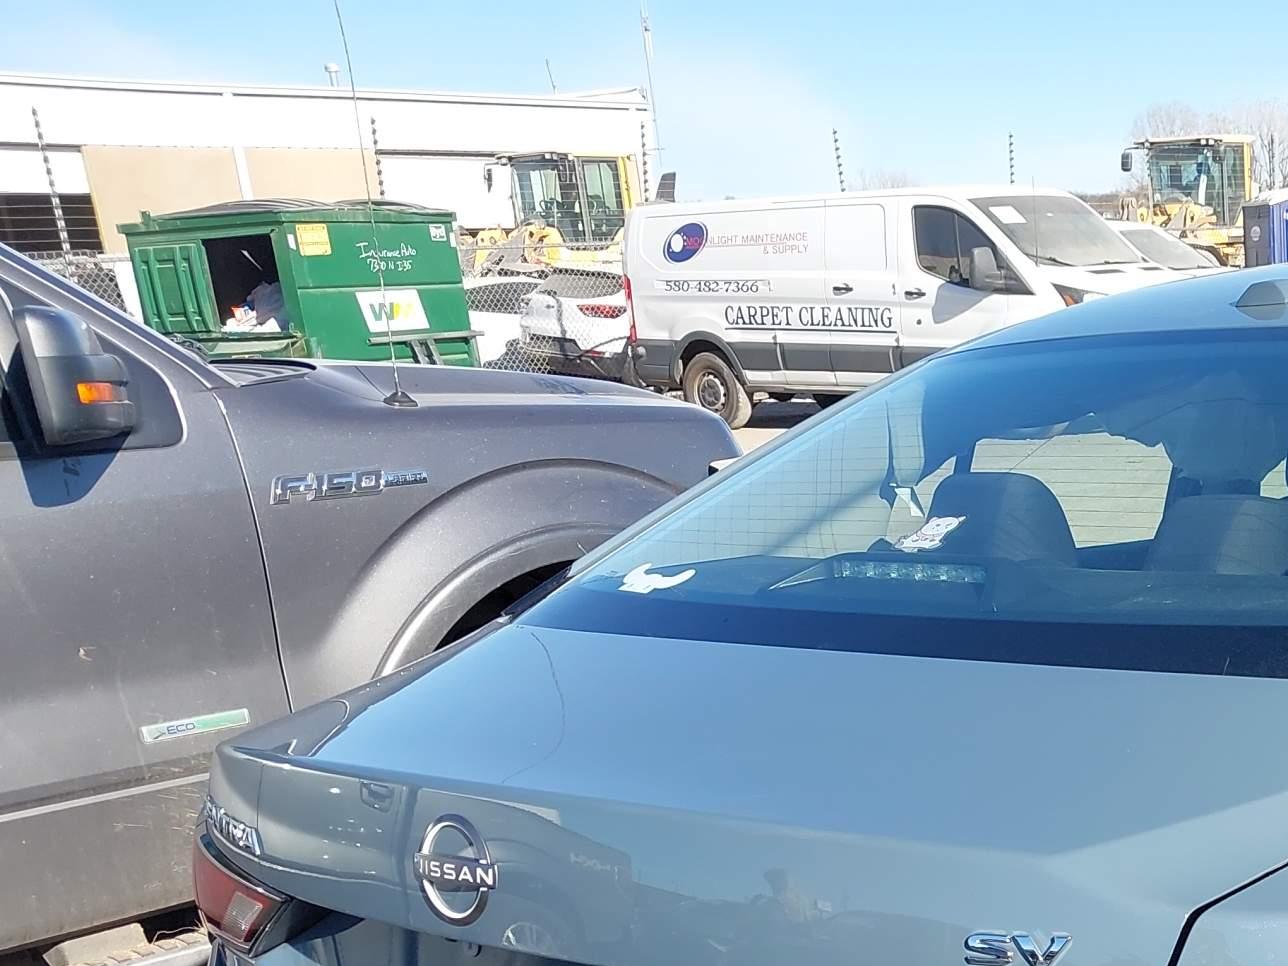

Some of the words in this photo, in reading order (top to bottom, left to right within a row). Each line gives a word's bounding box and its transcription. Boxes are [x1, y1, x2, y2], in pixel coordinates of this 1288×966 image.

[687, 233, 739, 249] MONLIGHT
[741, 231, 808, 244] MAINTENANCE
[763, 245, 769, 255] &
[772, 243, 808, 255] SUPPLY
[664, 280, 759, 293] 580-482-7366
[725, 305, 793, 326] CARPET
[799, 306, 893, 329] CLEANING
[166, 722, 196, 735] ECO
